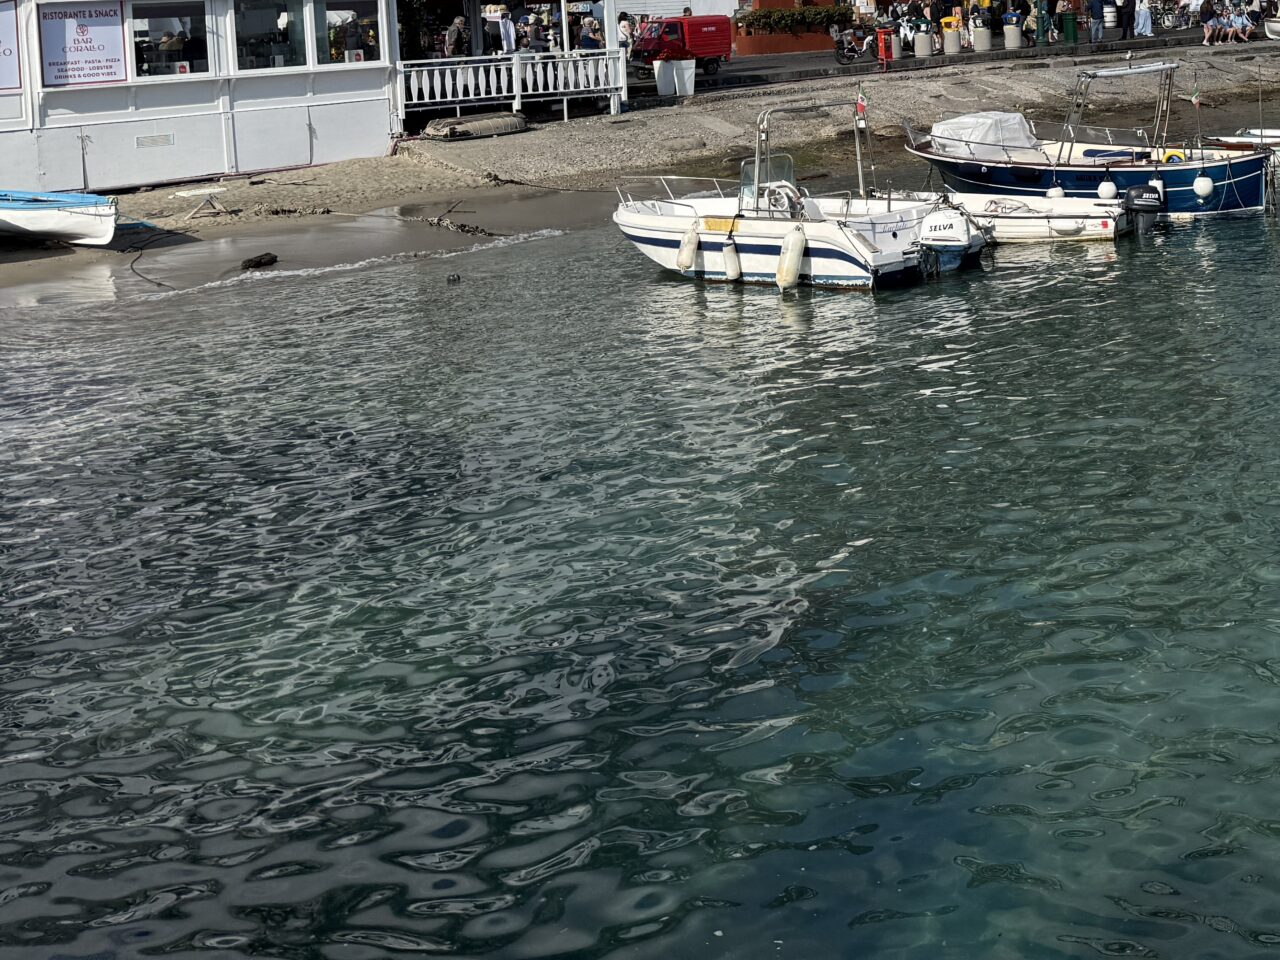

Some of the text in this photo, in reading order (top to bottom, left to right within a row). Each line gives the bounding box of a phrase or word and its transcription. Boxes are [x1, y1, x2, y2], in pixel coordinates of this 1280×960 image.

[42, 8, 119, 20] RISTORANTE & SNACK
[73, 37, 93, 45] BAR
[62, 44, 105, 54] CORALLO
[929, 223, 954, 232] SELVA
